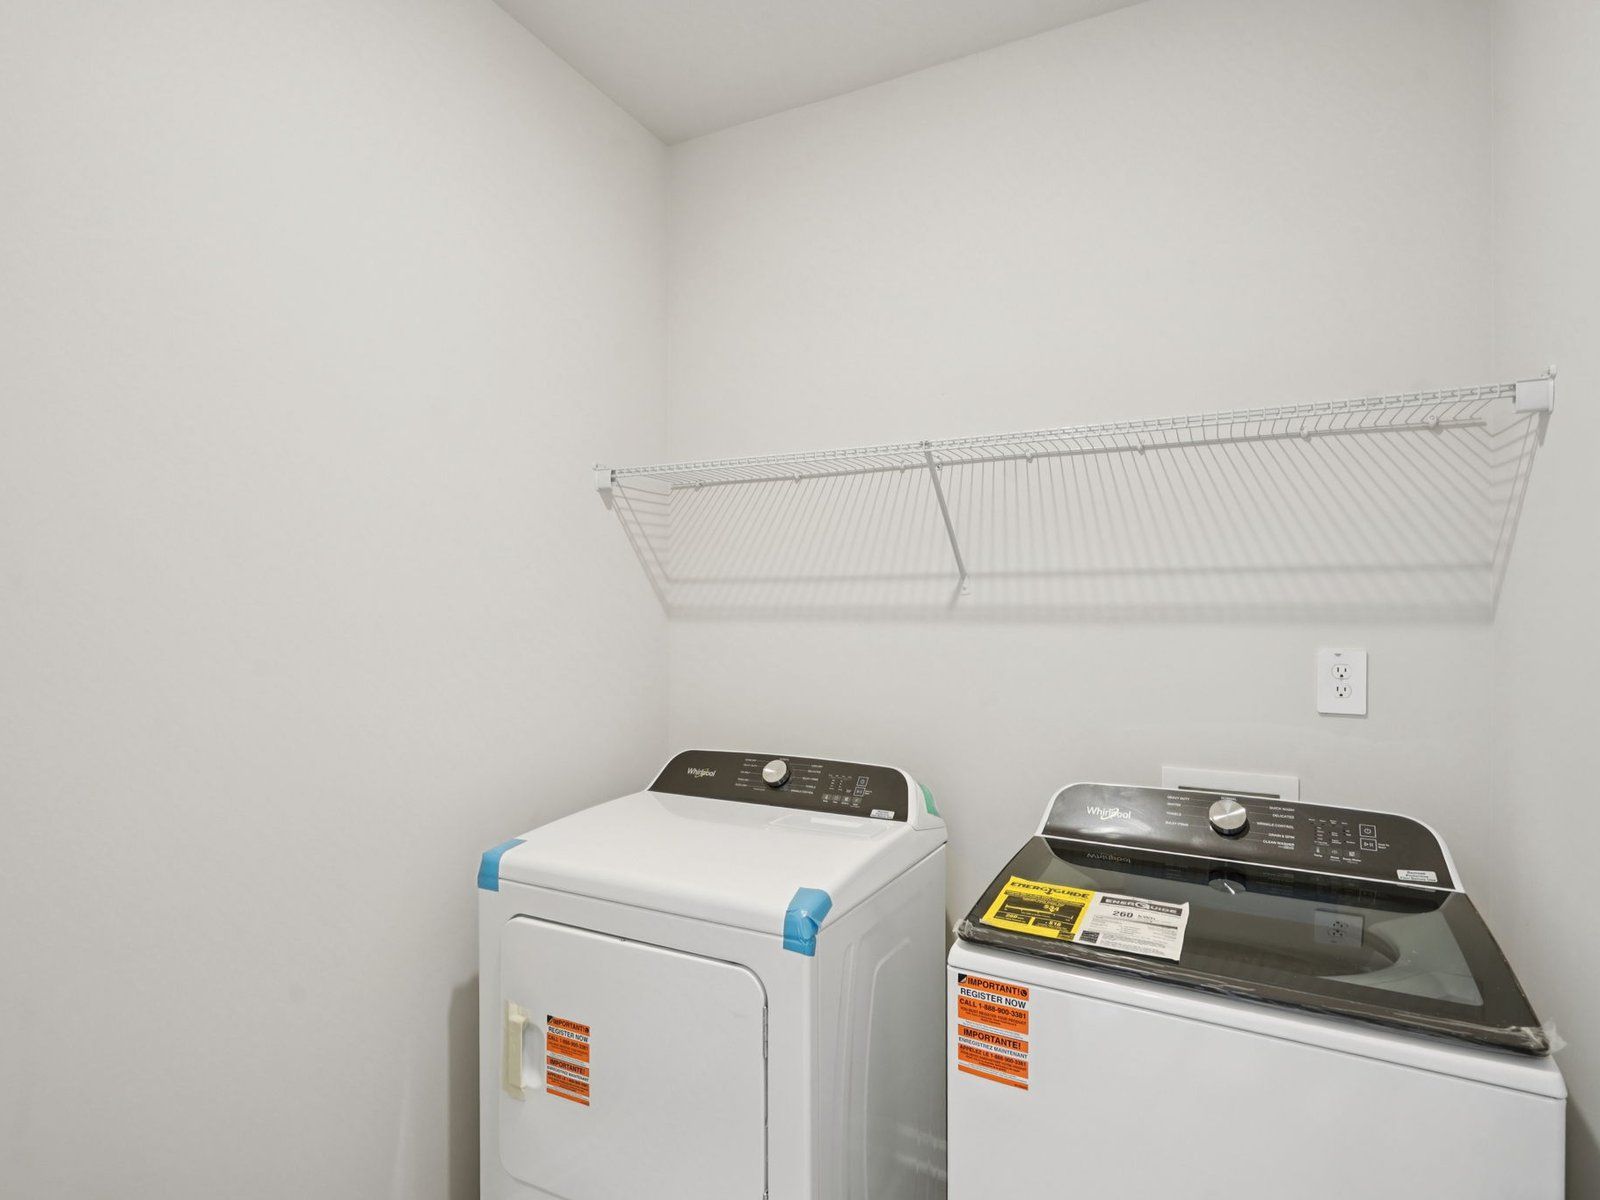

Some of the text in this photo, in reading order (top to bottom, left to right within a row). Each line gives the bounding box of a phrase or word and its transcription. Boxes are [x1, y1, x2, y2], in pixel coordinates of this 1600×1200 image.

[687, 767, 717, 778] Whirlpool
[1086, 805, 1132, 820] Whirlpool
[1112, 910, 1134, 919] 260
[967, 977, 1020, 995] IMPORTANT!
[960, 987, 1027, 1009] REGISTER NOW
[959, 998, 977, 1008] CALL
[978, 1002, 1026, 1019] 1-888-900-3381
[548, 1026, 589, 1043] REGISTER NOW
[963, 1028, 1021, 1050] IMPORTANTE!
[993, 1046, 1028, 1059] MAINTENANT
